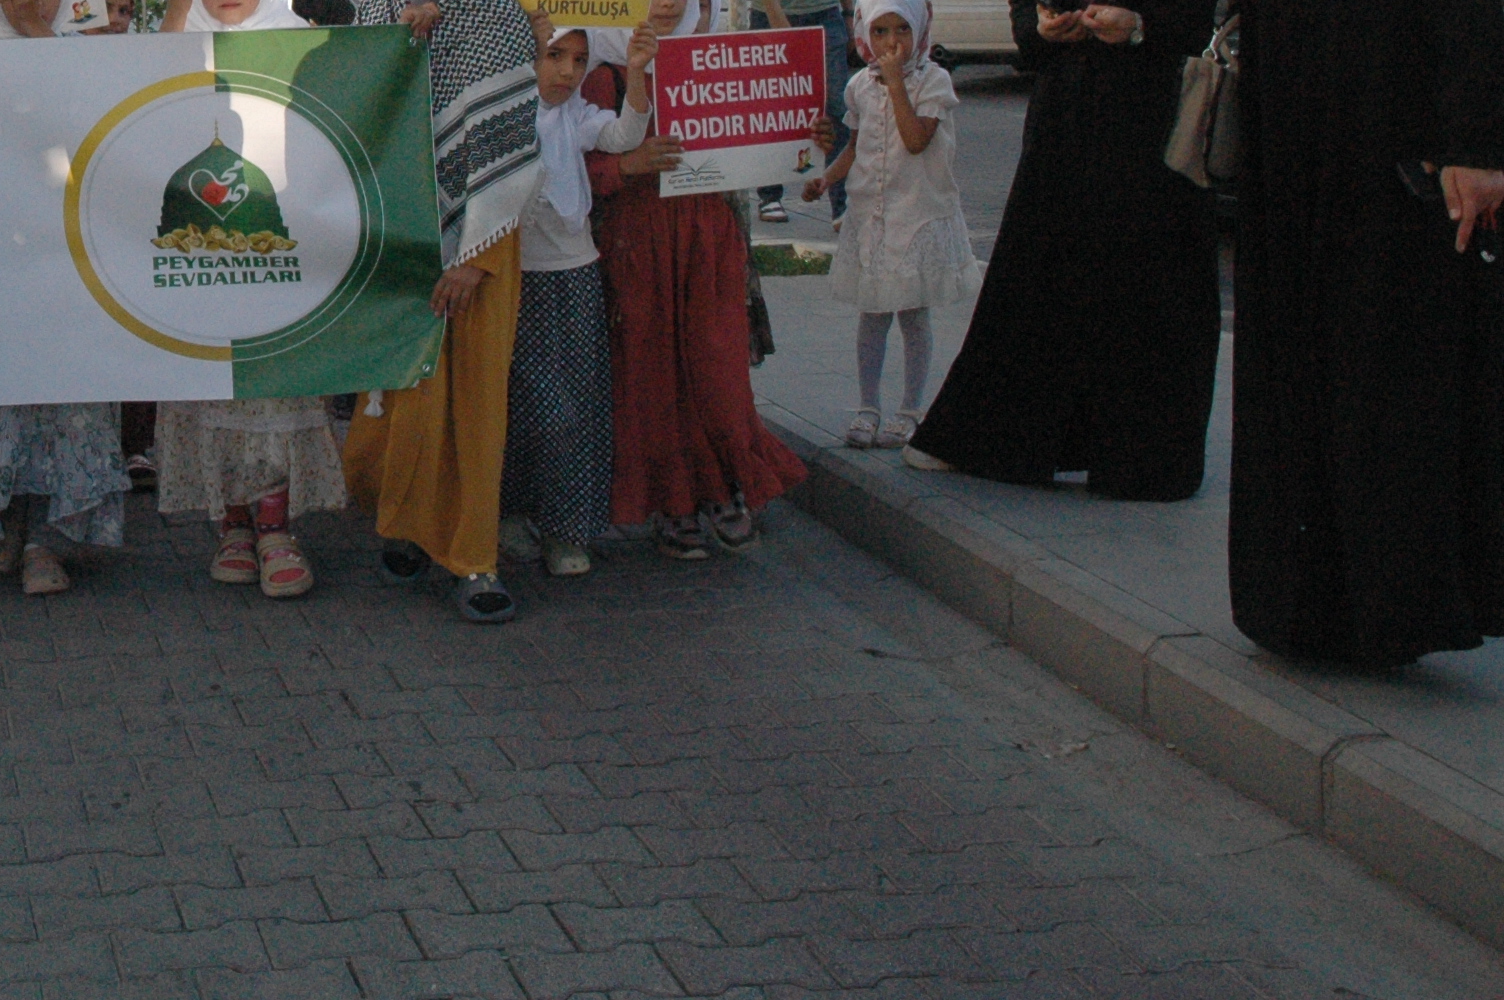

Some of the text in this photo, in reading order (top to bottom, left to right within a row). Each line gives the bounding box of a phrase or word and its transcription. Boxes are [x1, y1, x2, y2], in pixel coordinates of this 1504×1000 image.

[537, 0, 629, 19] KURTULUŞA
[691, 43, 789, 71] EĞİLEREK
[665, 71, 814, 107] YÜKSELMENİN
[669, 107, 819, 142] ADIDIR NAMAZ
[152, 255, 300, 271] PEYGAMBER
[153, 270, 302, 288] SEVDALILARI
